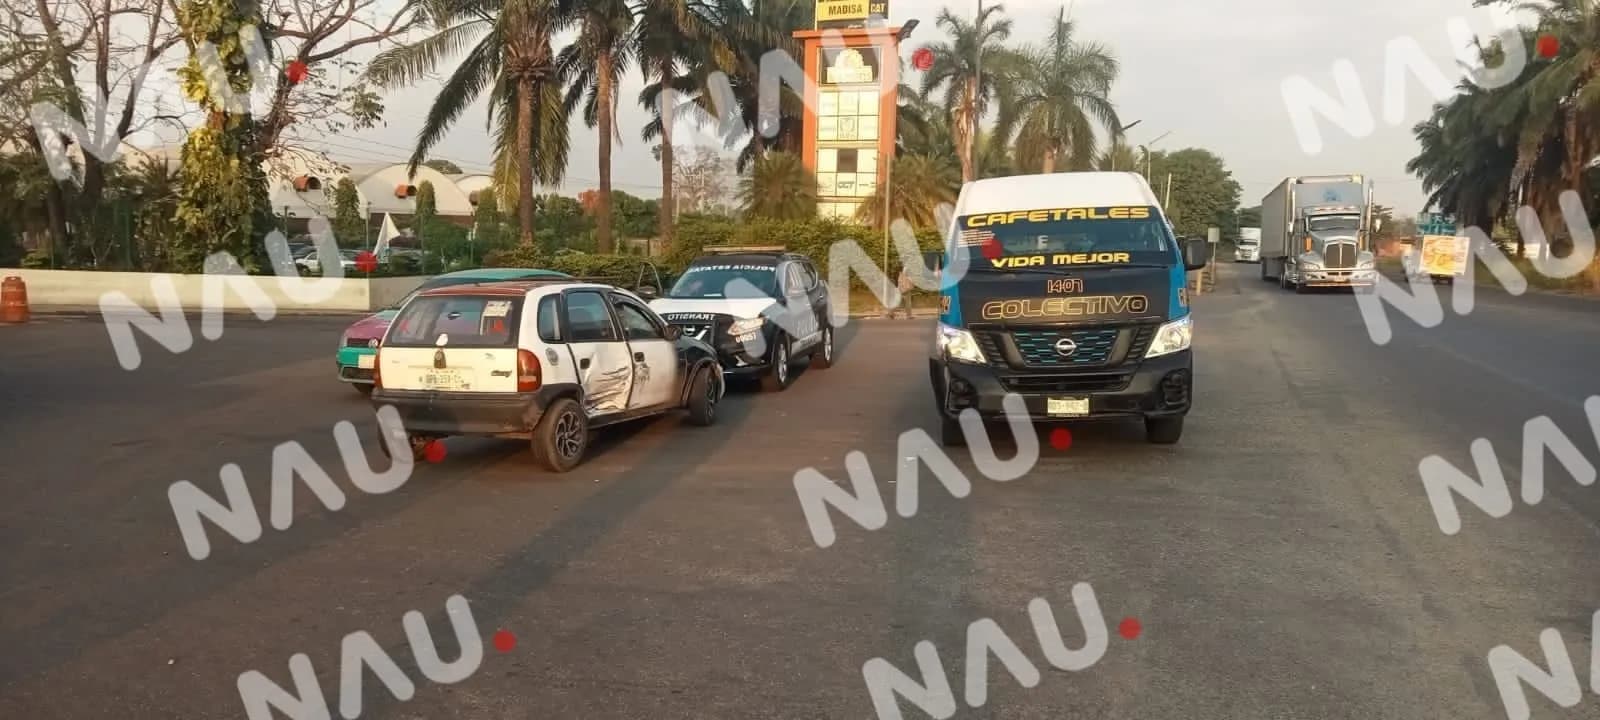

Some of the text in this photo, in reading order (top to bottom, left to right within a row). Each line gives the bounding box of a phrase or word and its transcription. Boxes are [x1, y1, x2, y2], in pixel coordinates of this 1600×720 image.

[828, 4, 863, 16] MADISA
[870, 3, 885, 14] CAT
[966, 206, 1150, 228] CAFETALES
[990, 252, 1131, 269] VIDA MEJOR
[982, 295, 1150, 320] COLECTIVO
